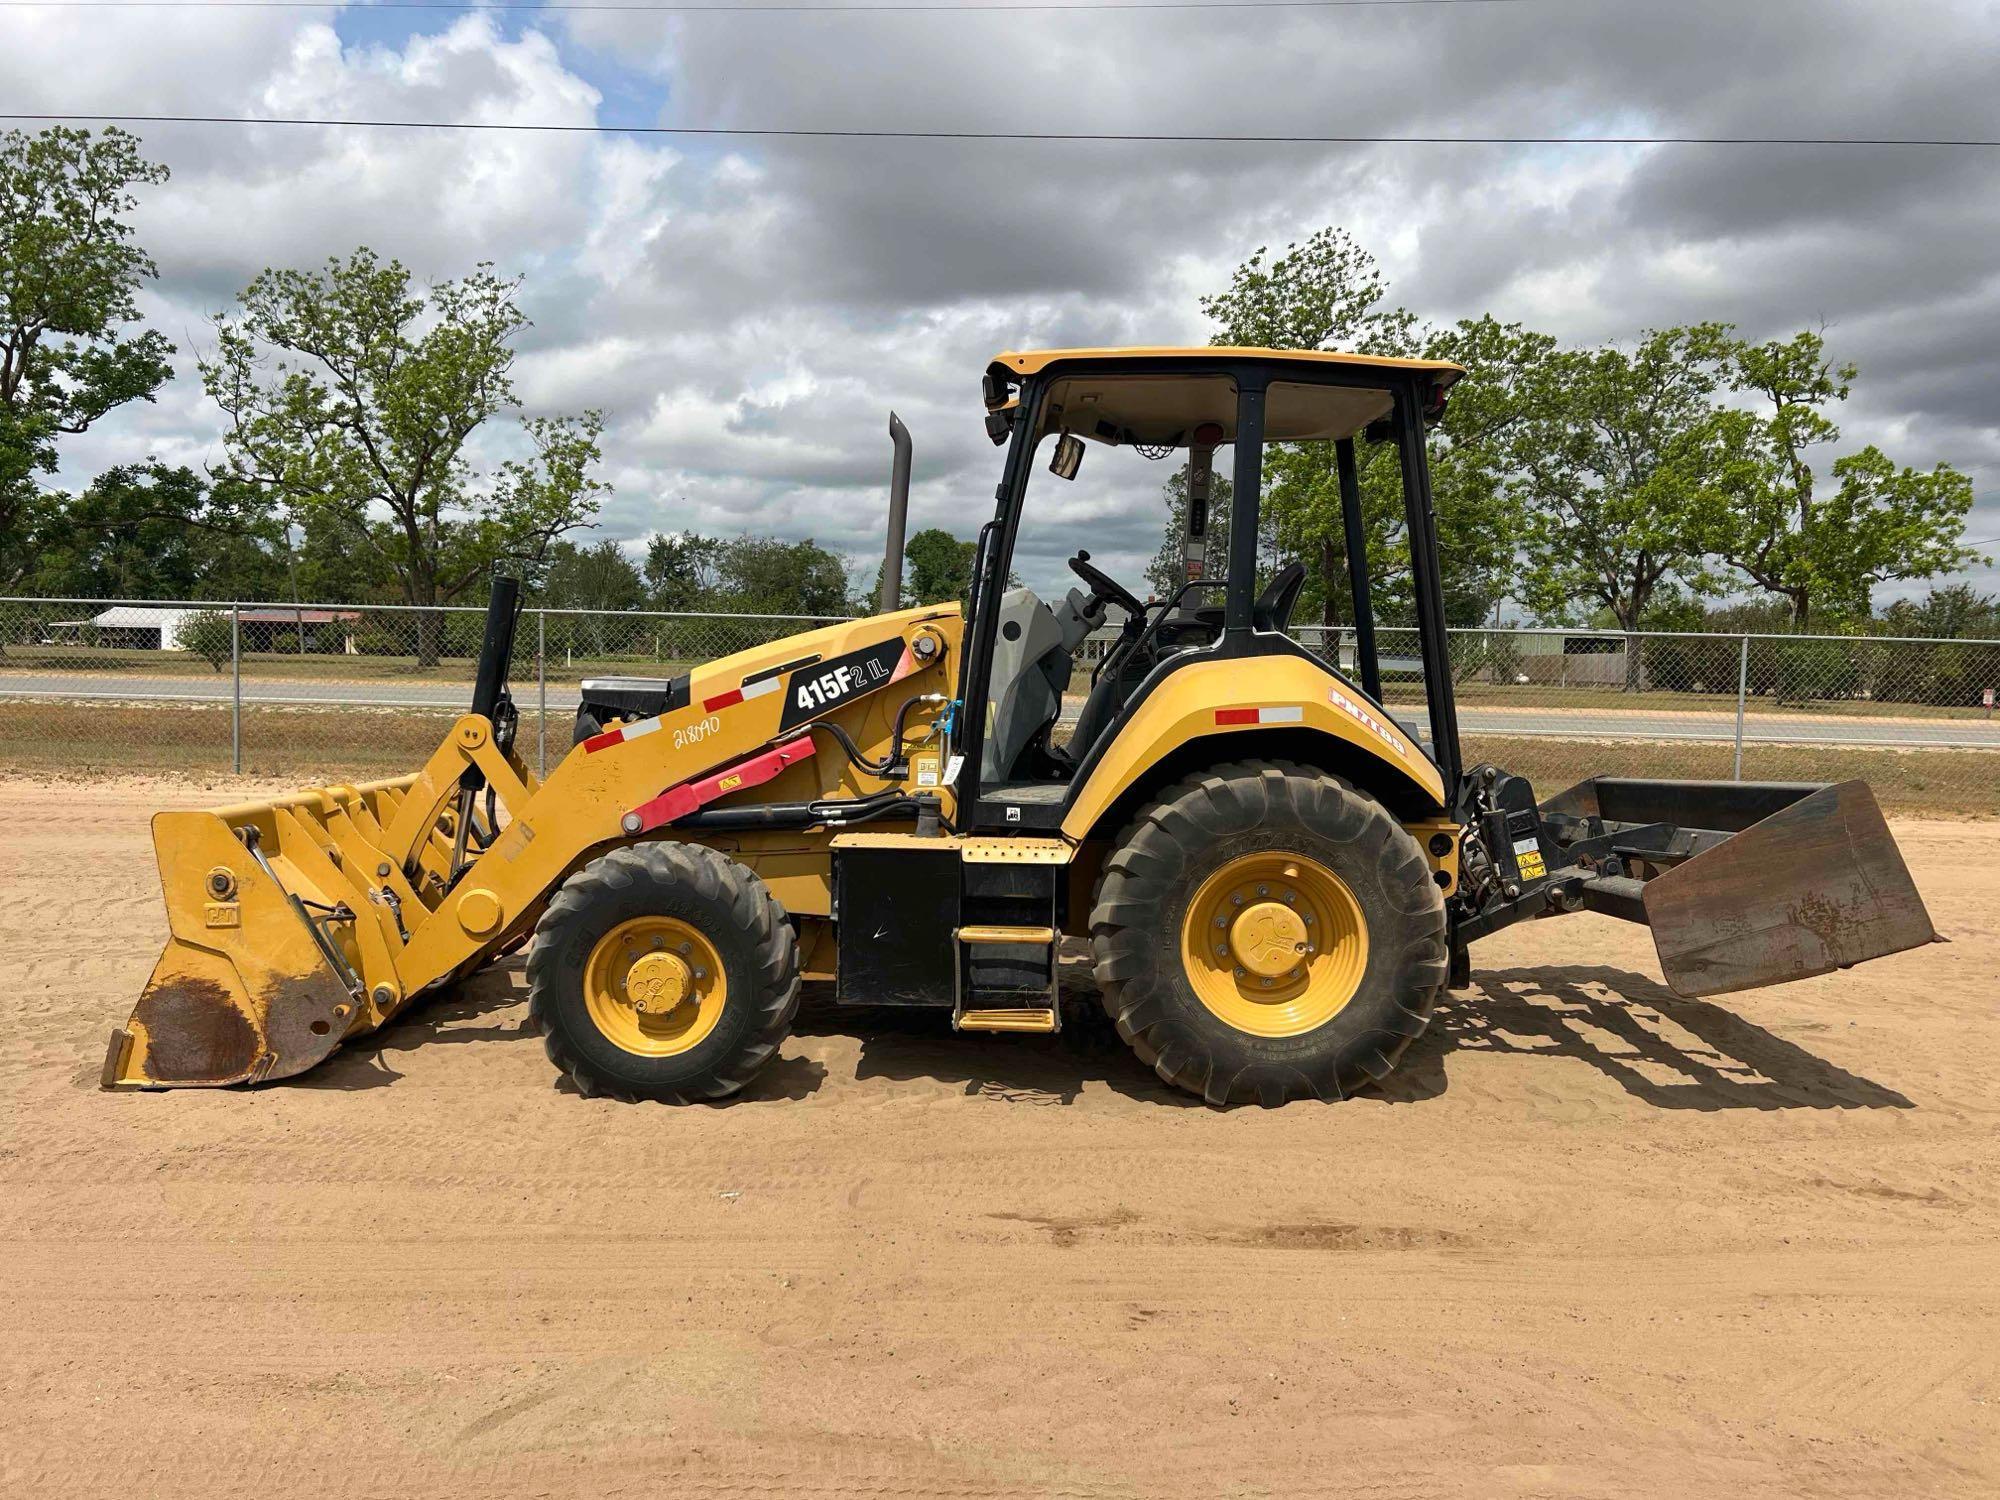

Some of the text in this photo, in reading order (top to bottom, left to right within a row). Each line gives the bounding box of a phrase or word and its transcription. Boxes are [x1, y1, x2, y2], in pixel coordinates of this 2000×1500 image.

[797, 658, 890, 710] 415F2 IL
[674, 716, 720, 750] 218090
